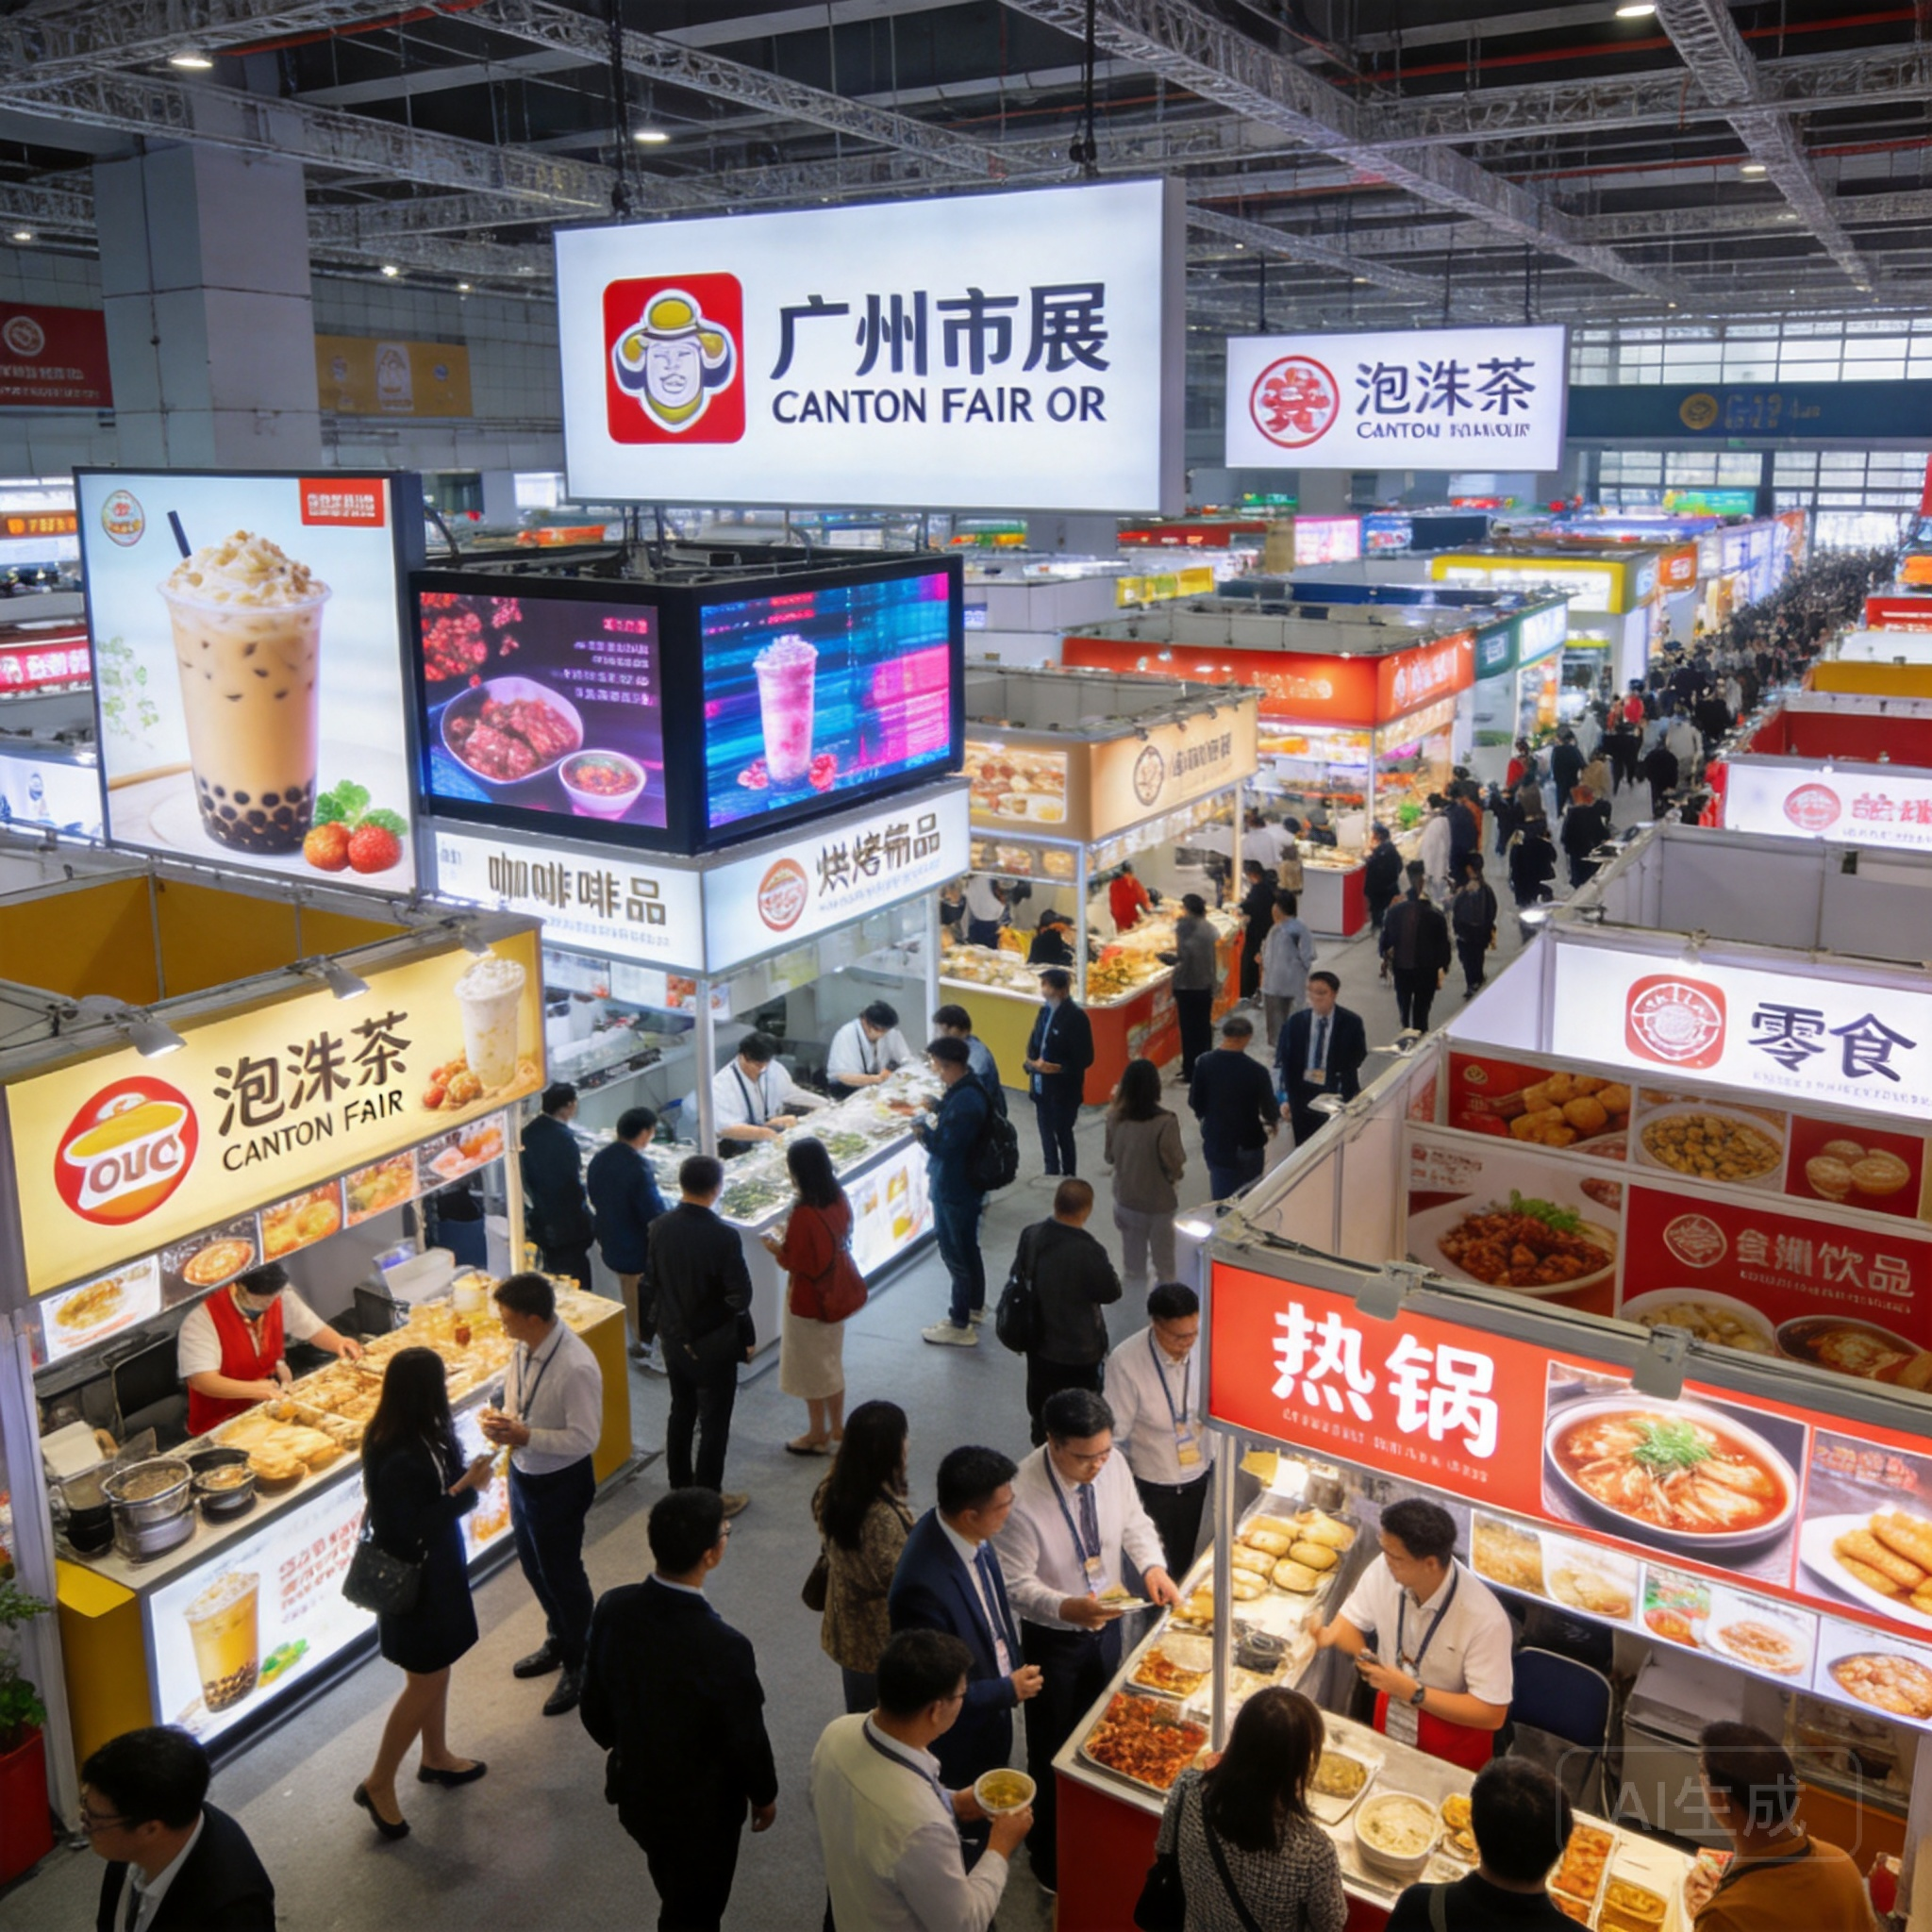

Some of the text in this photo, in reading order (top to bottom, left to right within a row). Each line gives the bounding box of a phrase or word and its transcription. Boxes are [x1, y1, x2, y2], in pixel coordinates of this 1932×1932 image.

[770, 282, 1111, 379] 广州市展
[772, 386, 1107, 425] CANTON FAIR OR
[1357, 422, 1441, 439] CANTON
[1747, 1002, 1917, 1082] 零食
[223, 1090, 404, 1171] CANTON FAIR
[1271, 1302, 1498, 1457] 热锅
